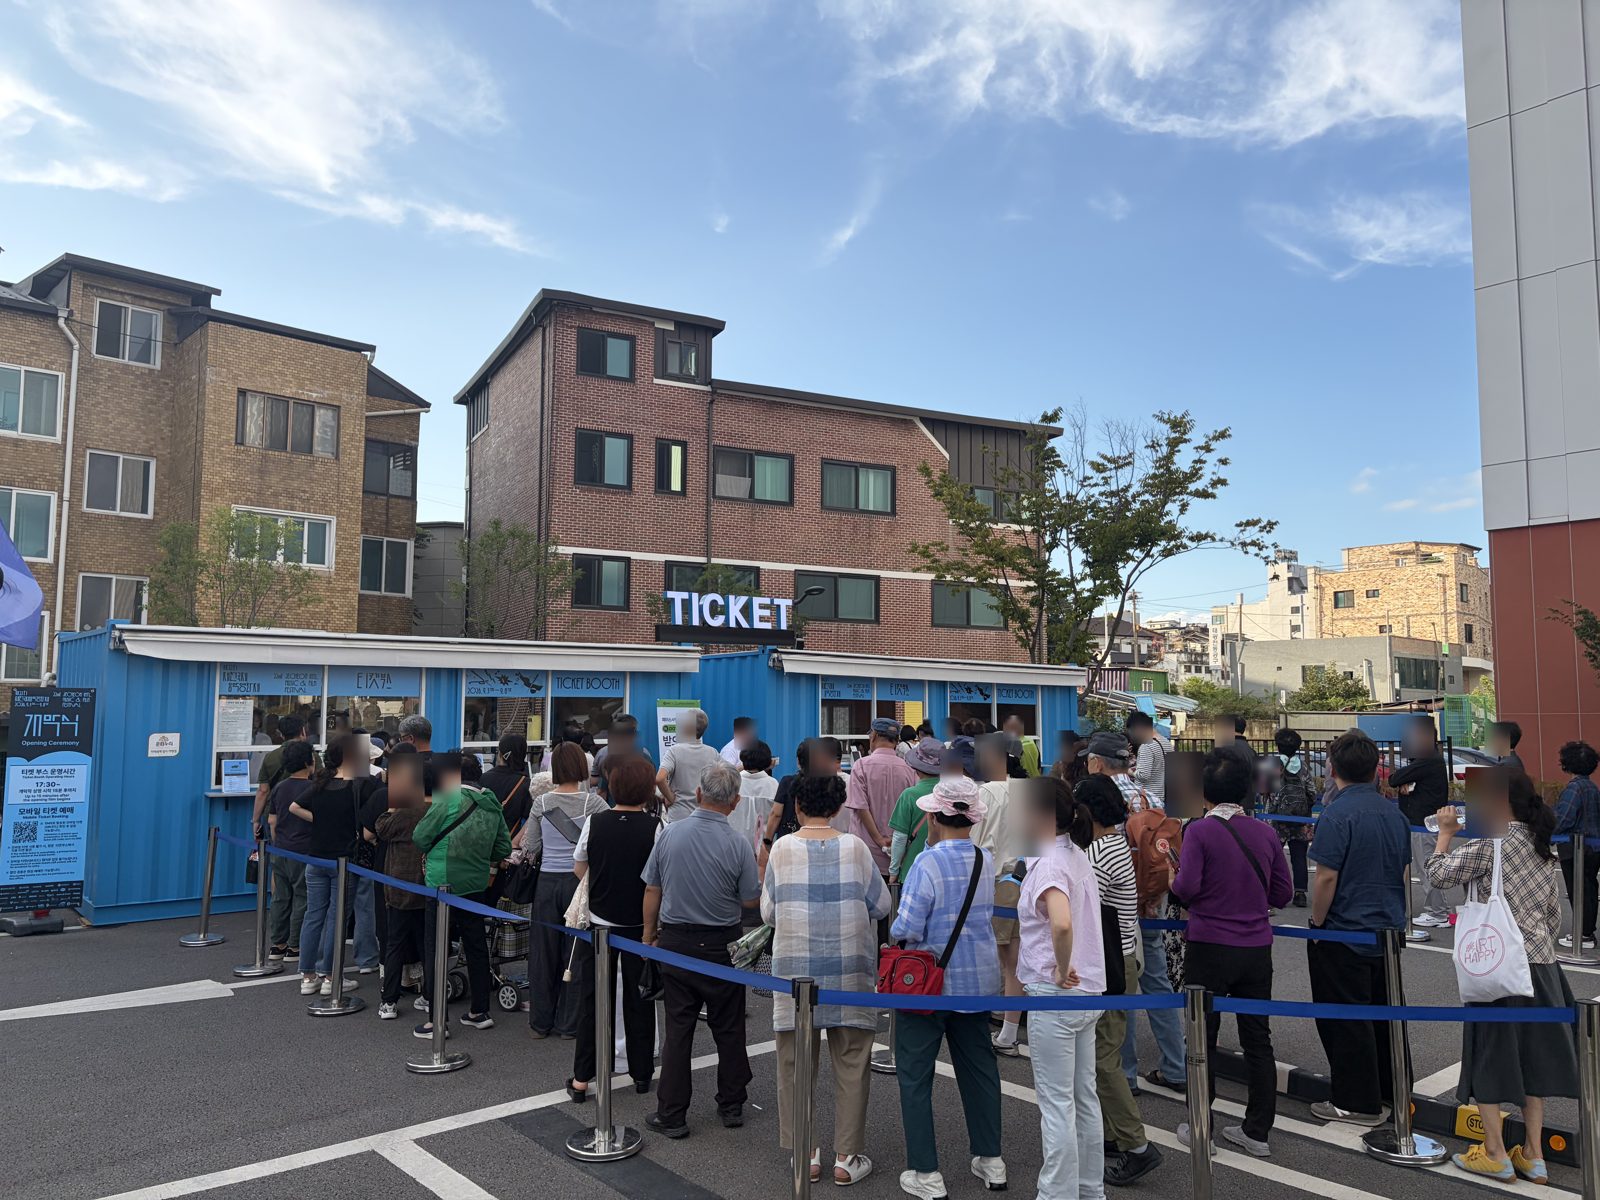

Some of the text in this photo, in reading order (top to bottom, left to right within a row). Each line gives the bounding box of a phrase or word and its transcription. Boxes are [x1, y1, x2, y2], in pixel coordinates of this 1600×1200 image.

[663, 590, 793, 630] TICKET
[356, 672, 392, 690] 티켓부스
[556, 677, 620, 690] TICKET BOOTH
[23, 714, 79, 737] 개막식
[42, 807, 58, 815] 티켓
[59, 806, 75, 814] 예매
[1465, 948, 1496, 963] HAPPY
[1469, 1118, 1484, 1129] STO
